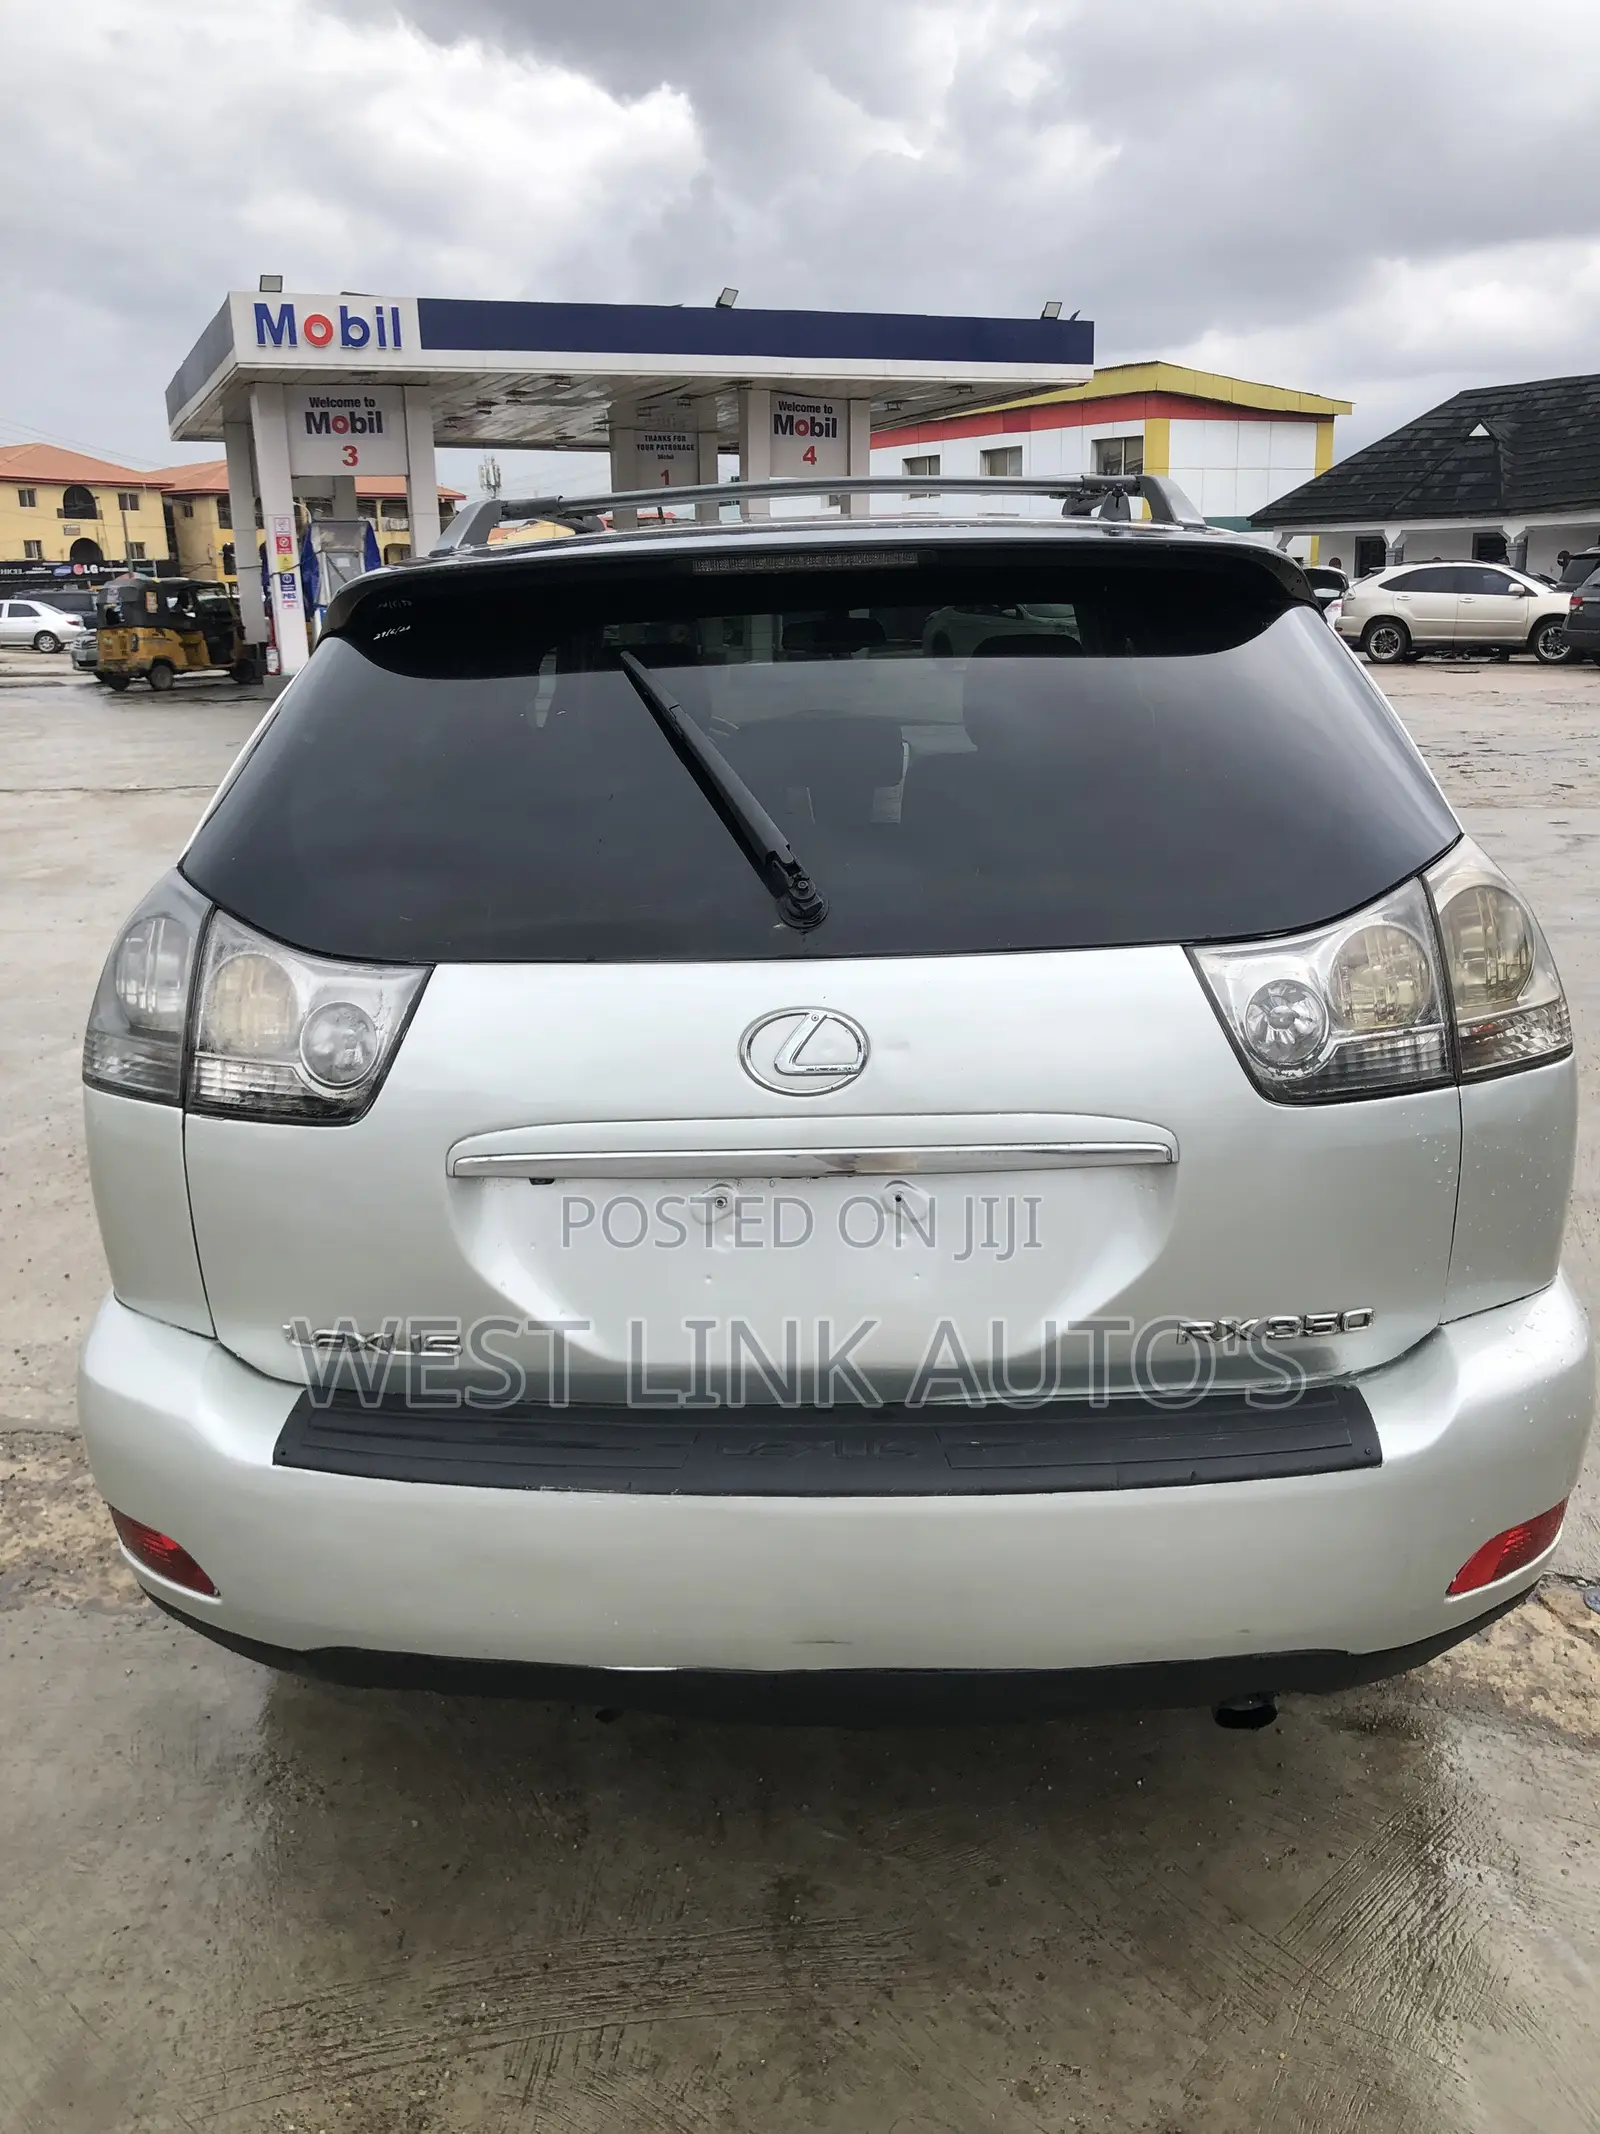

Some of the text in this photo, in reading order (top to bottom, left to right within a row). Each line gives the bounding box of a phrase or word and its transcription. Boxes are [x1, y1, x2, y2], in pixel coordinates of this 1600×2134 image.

[253, 302, 402, 349] Mobil
[308, 396, 376, 408] Welcome to
[778, 400, 833, 414] Welcome to
[304, 410, 384, 434] Mobil
[773, 413, 837, 438] Mobil
[341, 445, 359, 467] 3
[802, 445, 818, 466] 4
[660, 469, 670, 486] 1
